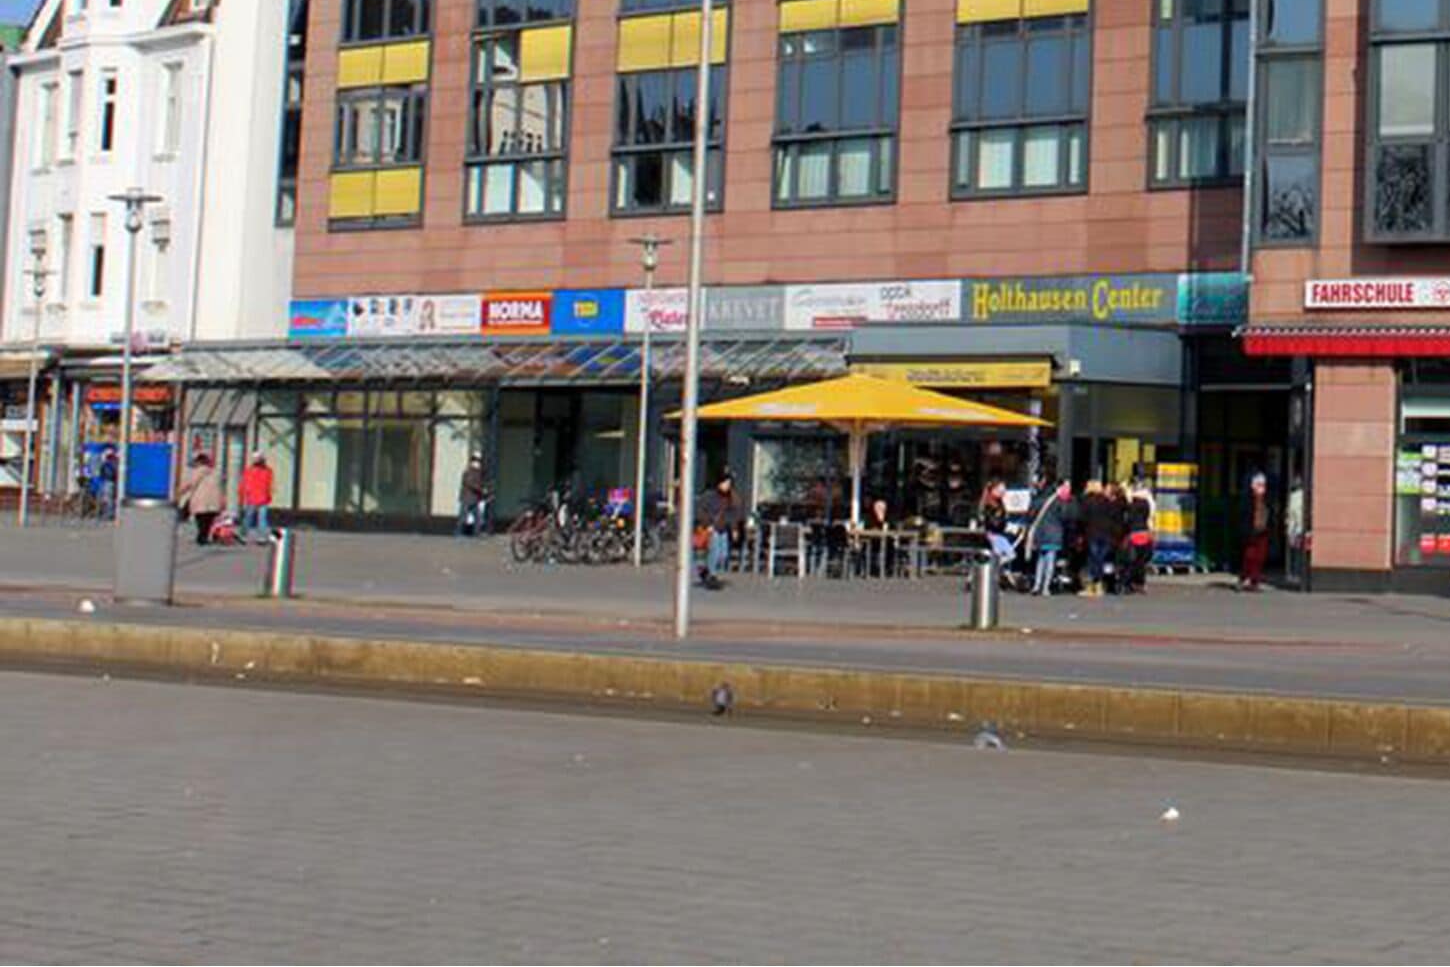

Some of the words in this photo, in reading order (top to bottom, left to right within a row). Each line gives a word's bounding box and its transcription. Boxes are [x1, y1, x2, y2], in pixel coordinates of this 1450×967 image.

[972, 282, 1087, 320] Holthausen
[1092, 279, 1163, 320] Center
[1311, 282, 1415, 304] FAHRSCHULE
[488, 300, 544, 320] NORMA
